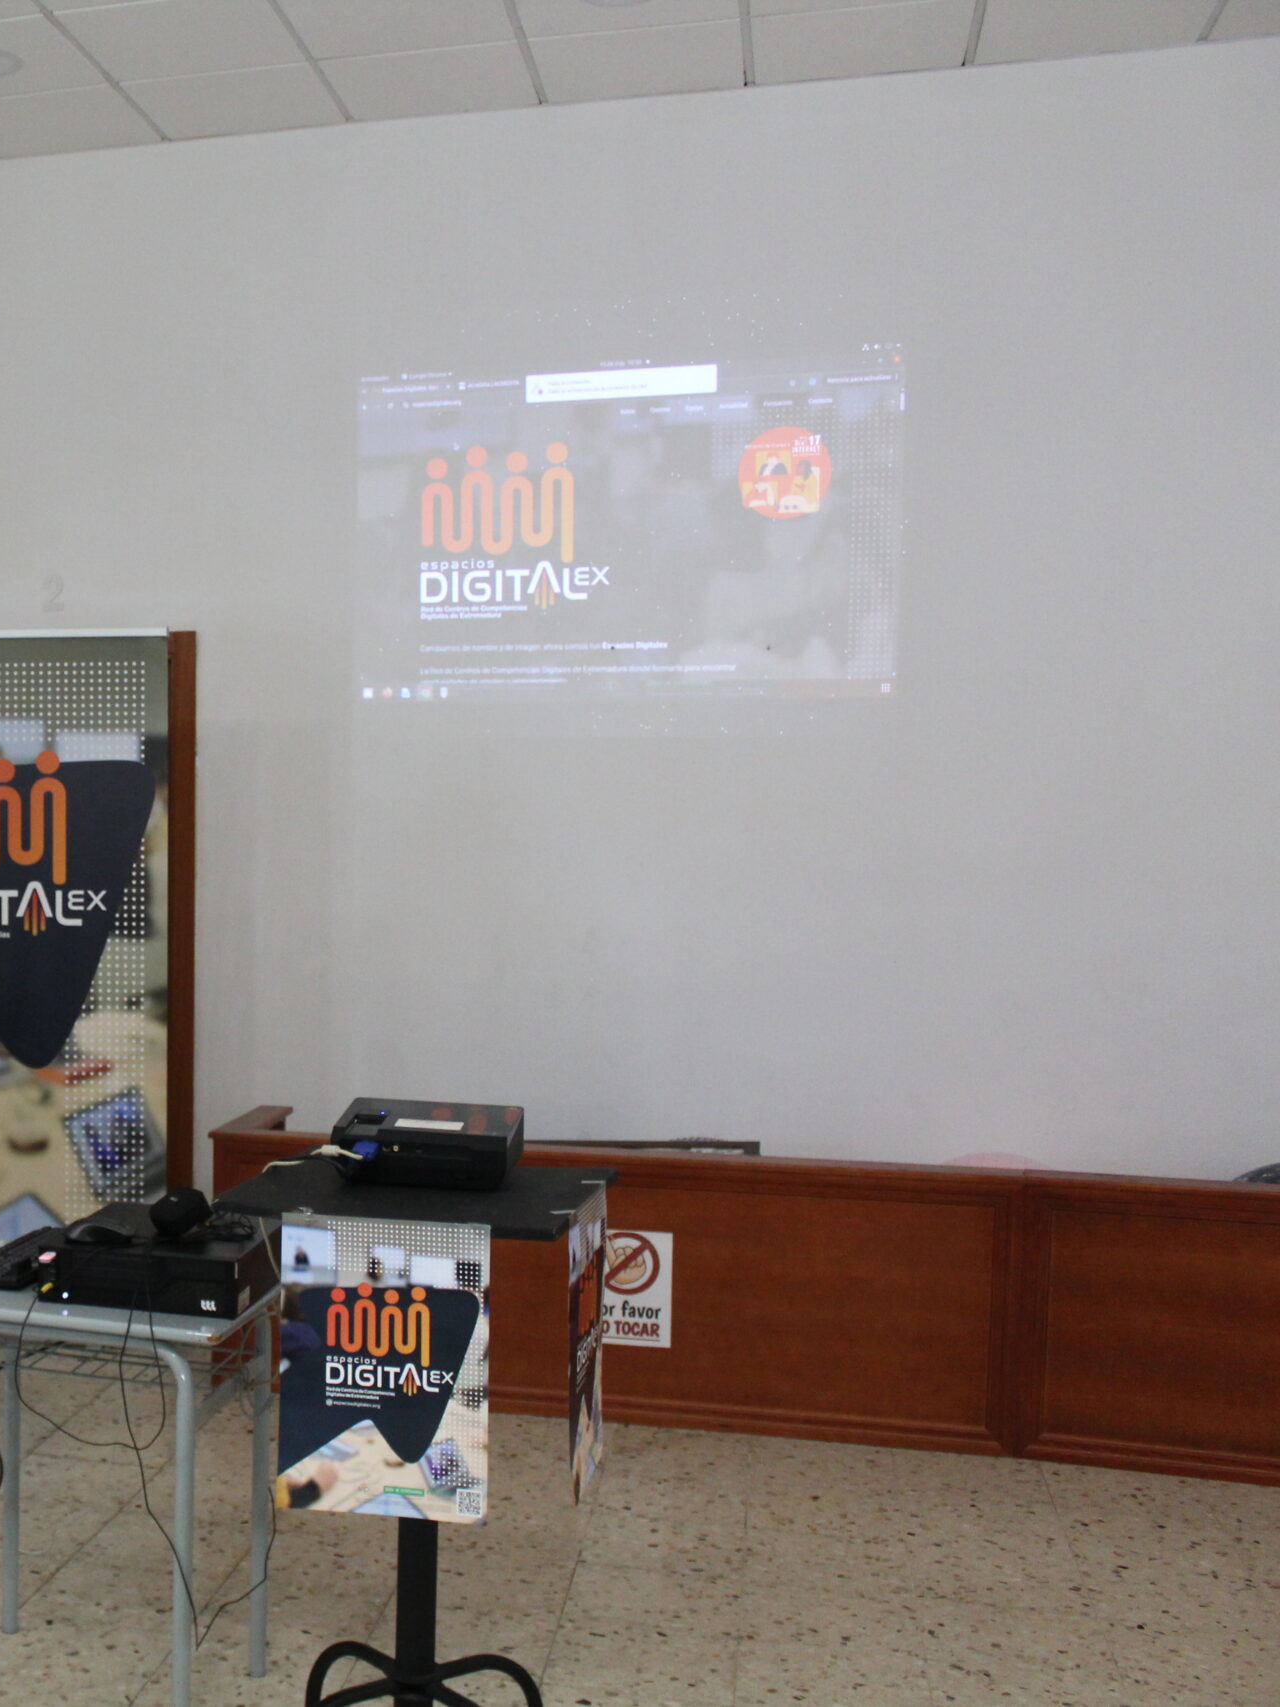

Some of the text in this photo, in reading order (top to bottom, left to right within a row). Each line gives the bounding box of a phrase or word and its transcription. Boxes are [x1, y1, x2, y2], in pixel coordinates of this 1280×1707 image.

[420, 558, 495, 571] espacios
[419, 560, 610, 604] DIGITALEX
[602, 1300, 661, 1320] or favor
[614, 1320, 660, 1338] TOCAR
[326, 1355, 377, 1365] espacios
[325, 1362, 454, 1393] DIGITALEX
